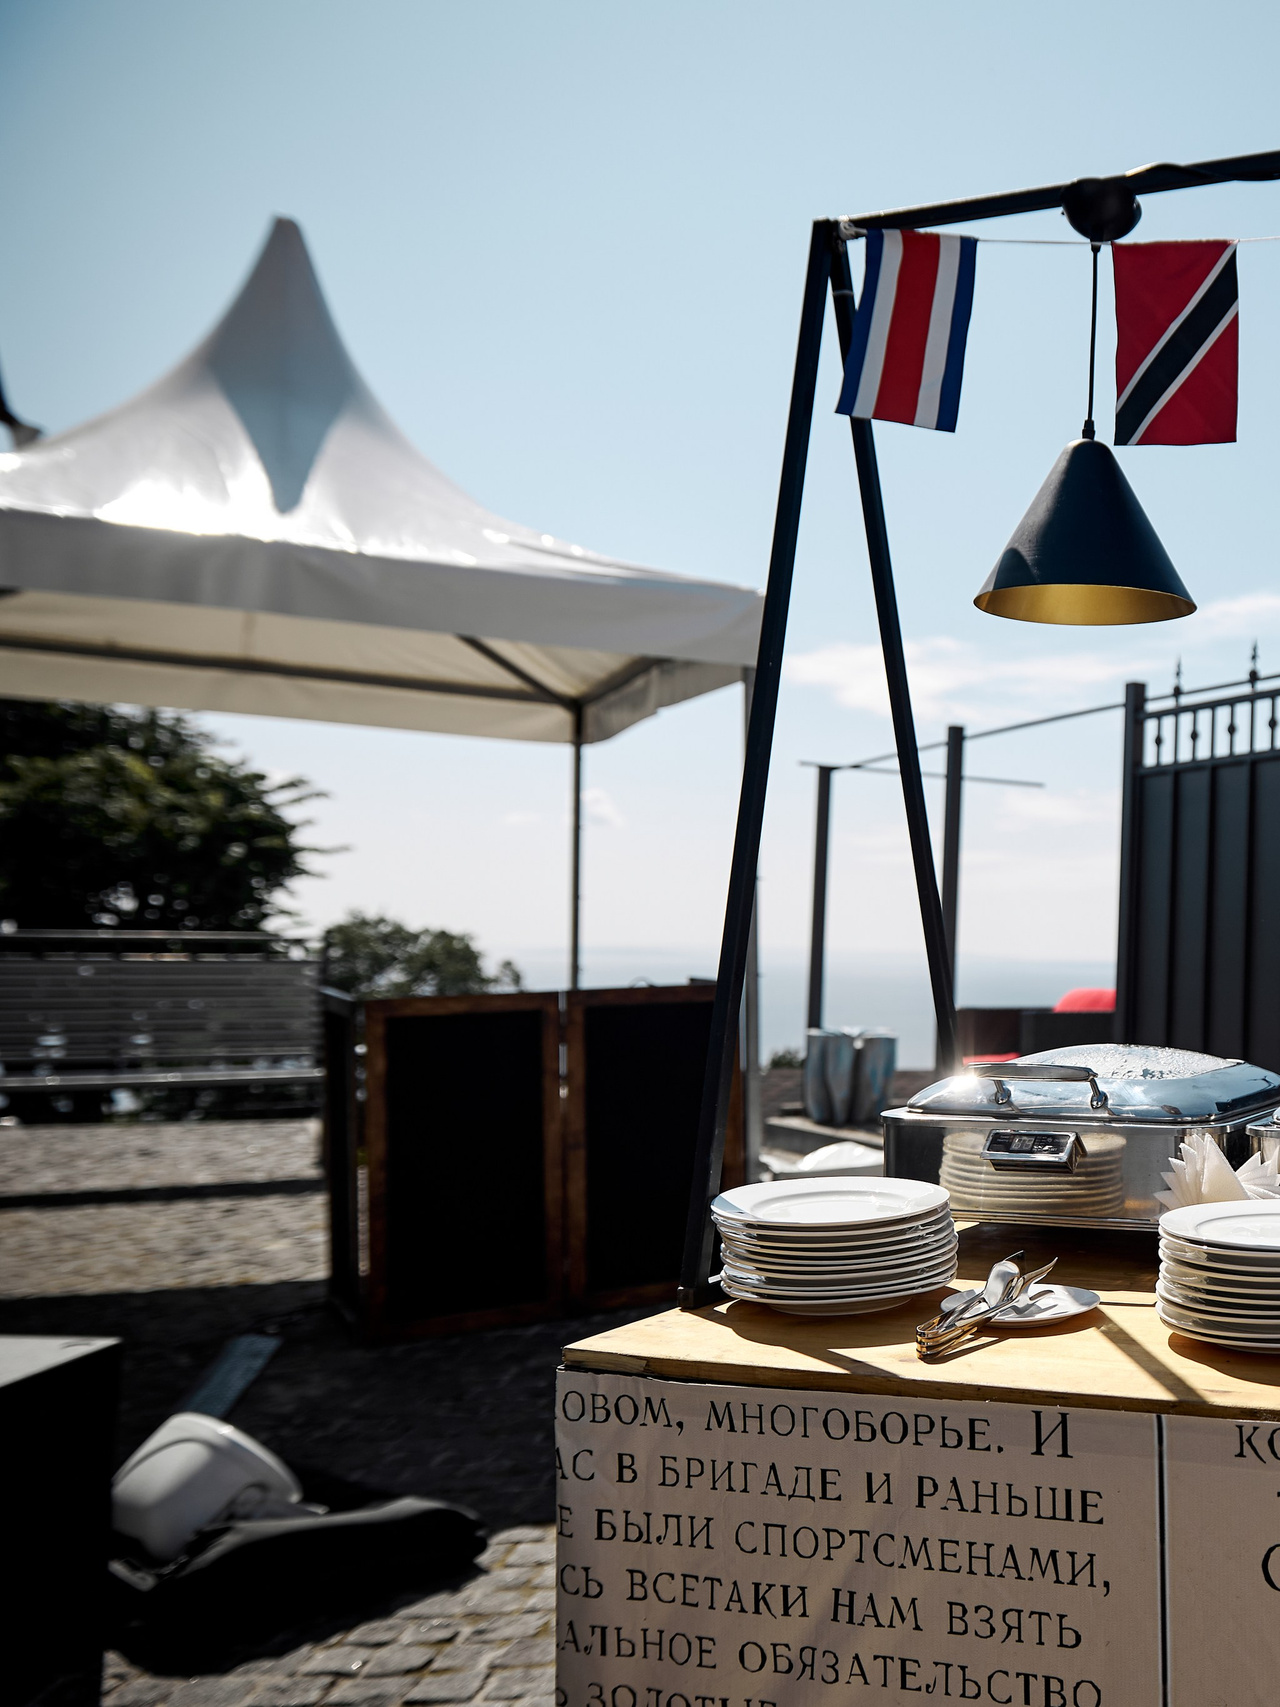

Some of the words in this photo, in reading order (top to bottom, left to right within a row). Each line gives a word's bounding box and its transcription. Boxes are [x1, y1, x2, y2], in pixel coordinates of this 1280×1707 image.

[557, 1391, 684, 1436] ОВОМ,
[705, 1401, 1003, 1453] МНОГОБОРЬЕ.
[1031, 1410, 1073, 1458] И
[616, 1453, 637, 1483] В
[658, 1456, 841, 1502] БРИГАДЕ
[865, 1472, 893, 1504] И
[915, 1476, 1103, 1525] РАНЬШЕ
[595, 1509, 714, 1549] БЫЛИ
[735, 1521, 1110, 1597] СПОРТСМЕНАМИ,
[560, 1564, 604, 1599] СЬ
[626, 1569, 809, 1619] ВСЕТАКИ
[831, 1588, 923, 1631] НАМ
[947, 1601, 1081, 1649] ВЗЯТЬ
[556, 1620, 717, 1669] АЛЬНОЕ
[739, 1642, 1101, 1707] ОБЯЗАТЕЛЬСТВО
